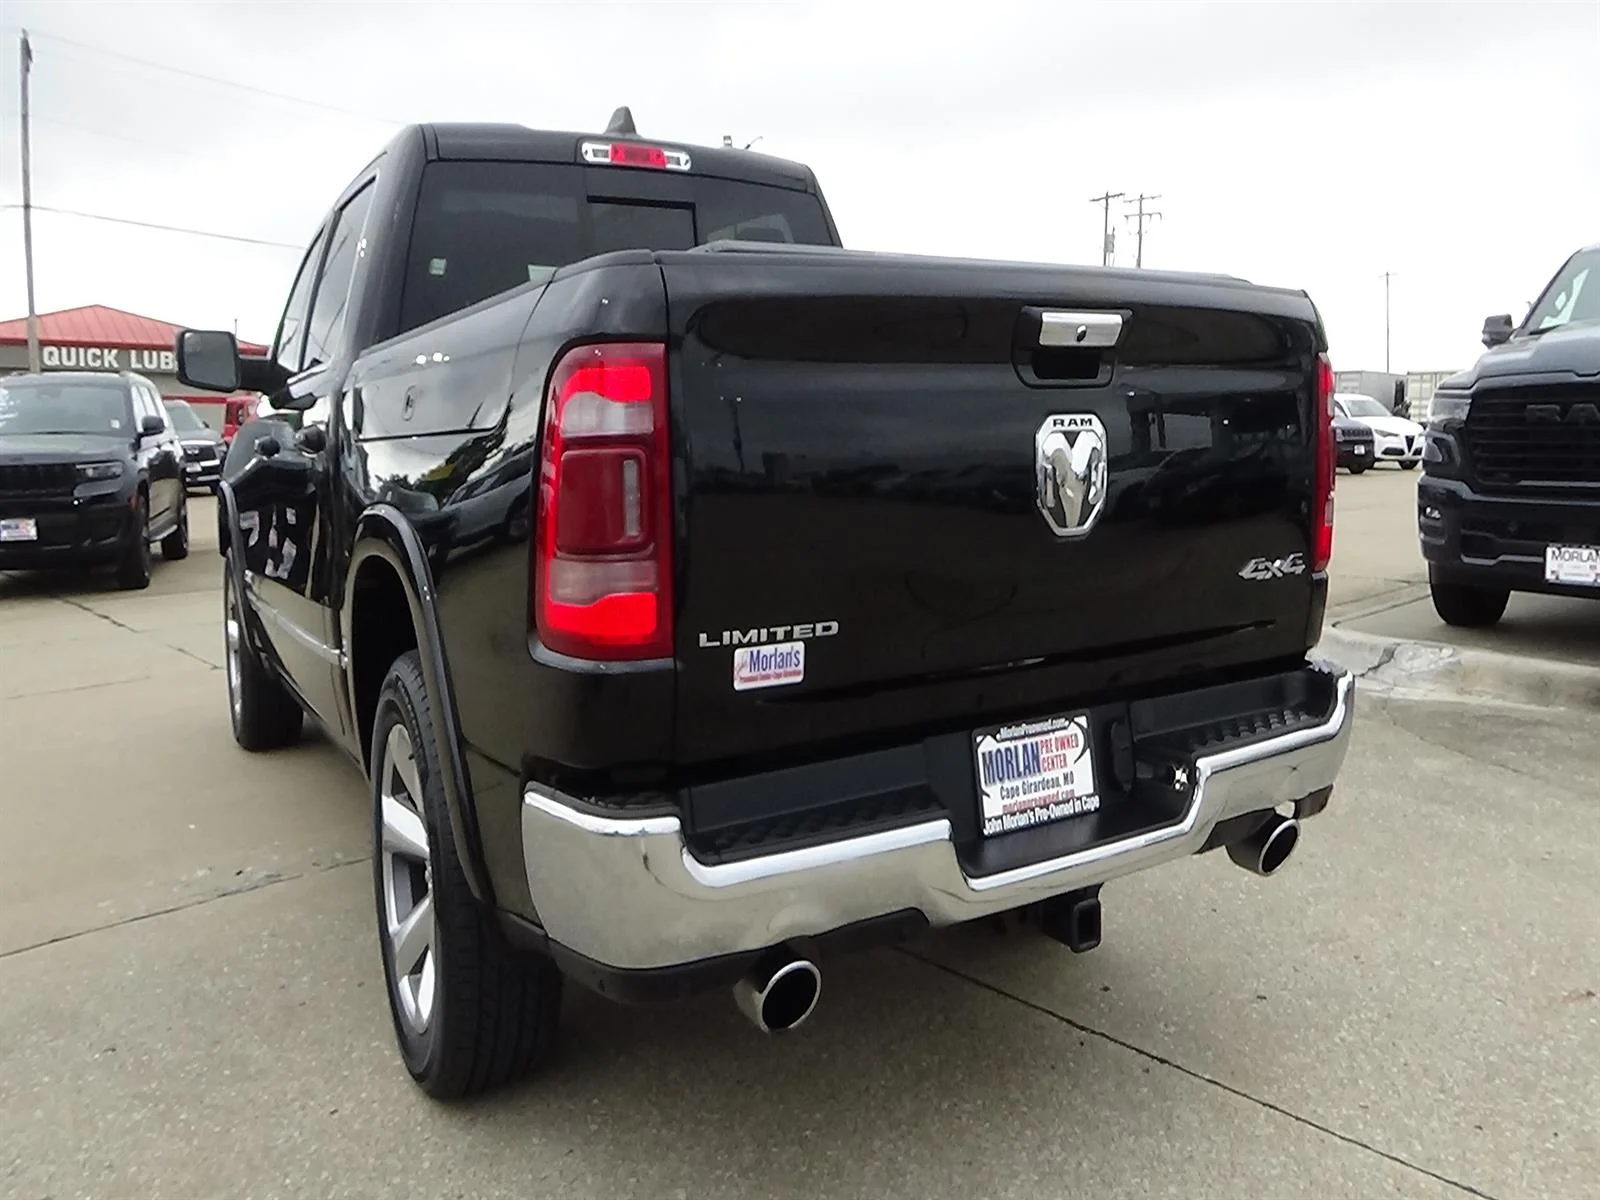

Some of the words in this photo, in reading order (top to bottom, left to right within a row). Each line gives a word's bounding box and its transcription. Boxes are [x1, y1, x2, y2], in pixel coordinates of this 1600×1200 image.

[43, 346, 119, 368] QUICK
[130, 350, 178, 371] LUB
[1053, 418, 1093, 427] RAM
[1551, 549, 1600, 563] MORLA
[699, 620, 839, 648] LIMITED
[749, 647, 801, 673] Morlan's
[981, 740, 1041, 787] MORLAN
[1040, 737, 1054, 755] PRE
[1054, 733, 1080, 752] OWNED
[1041, 753, 1068, 773] CENTER
[1000, 784, 1020, 800] Cape
[1063, 771, 1075, 786] MO
[983, 818, 1003, 836] John
[1003, 810, 1035, 831] Morlan's
[1074, 798, 1082, 813] in
[1082, 795, 1100, 812] Cape
